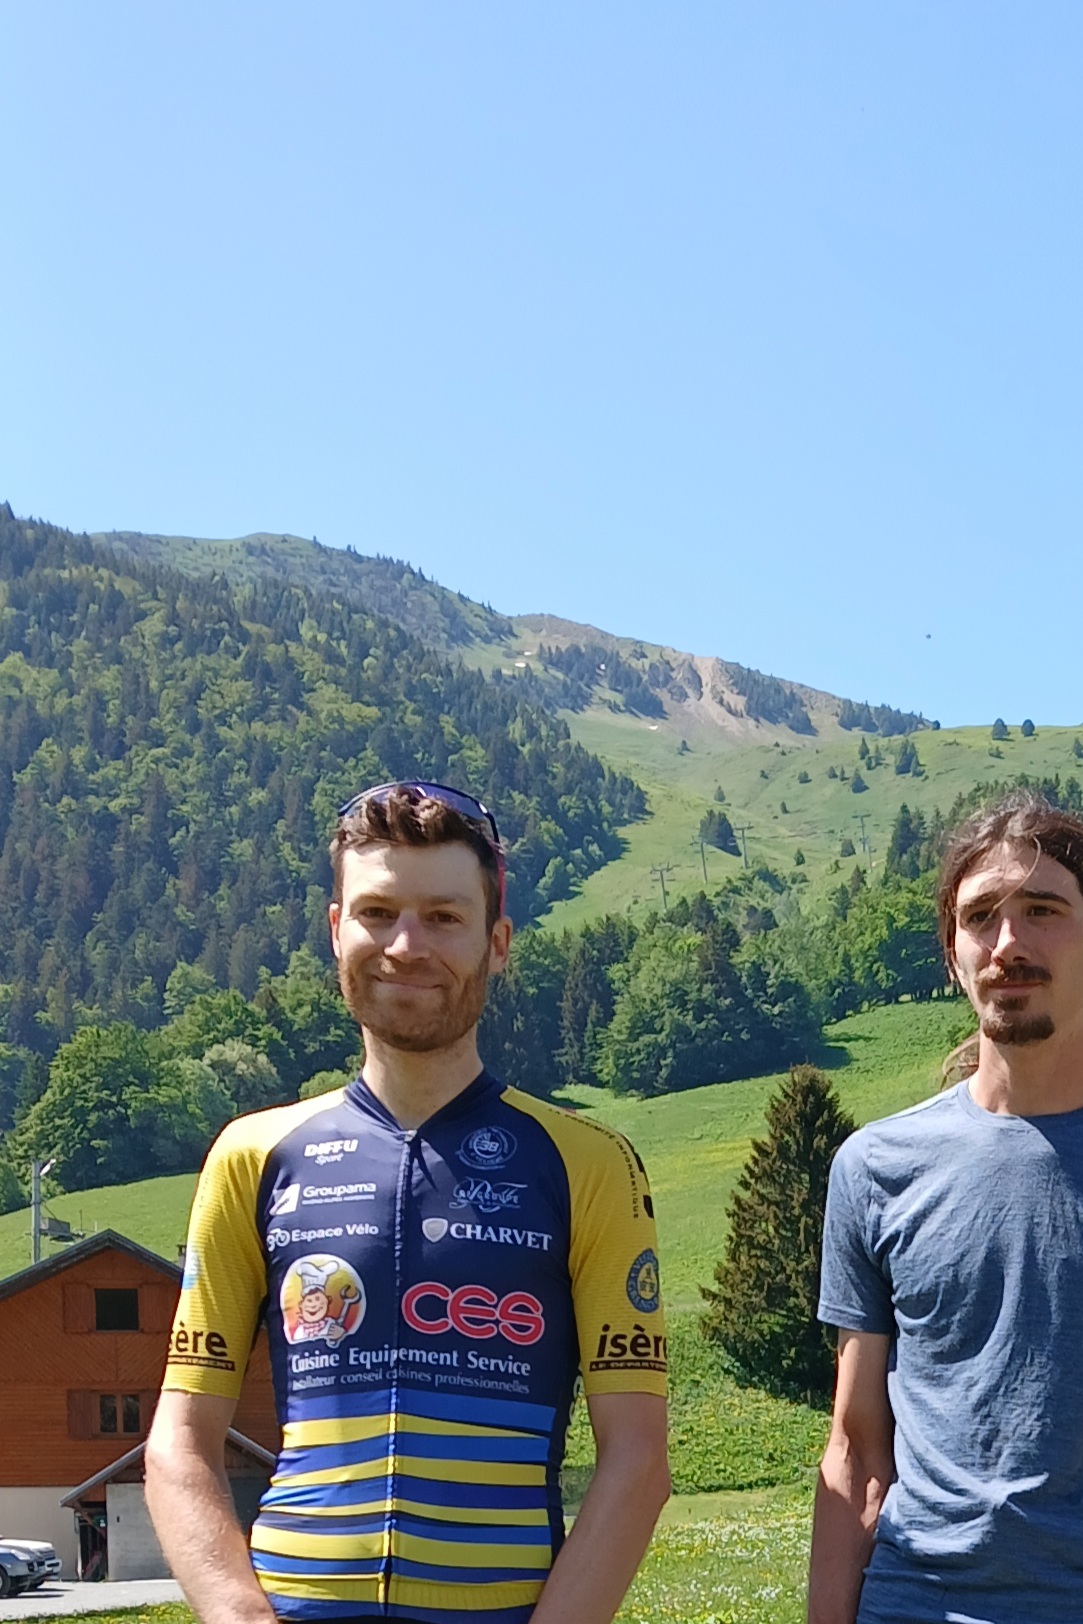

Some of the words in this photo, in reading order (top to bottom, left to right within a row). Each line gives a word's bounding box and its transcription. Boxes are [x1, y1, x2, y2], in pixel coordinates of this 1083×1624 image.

[304, 1139, 358, 1157] DIFFU
[302, 1182, 377, 1199] Groupama
[291, 1227, 344, 1243] Espace
[345, 1223, 379, 1236] Vélo
[449, 1221, 553, 1251] CHARVET
[402, 1281, 546, 1346] CES
[291, 1350, 340, 1374] Cuisine
[349, 1344, 459, 1370] Equipement
[467, 1350, 531, 1377] Service
[340, 1367, 383, 1384] conseil
[434, 1372, 530, 1395] professionnelles
